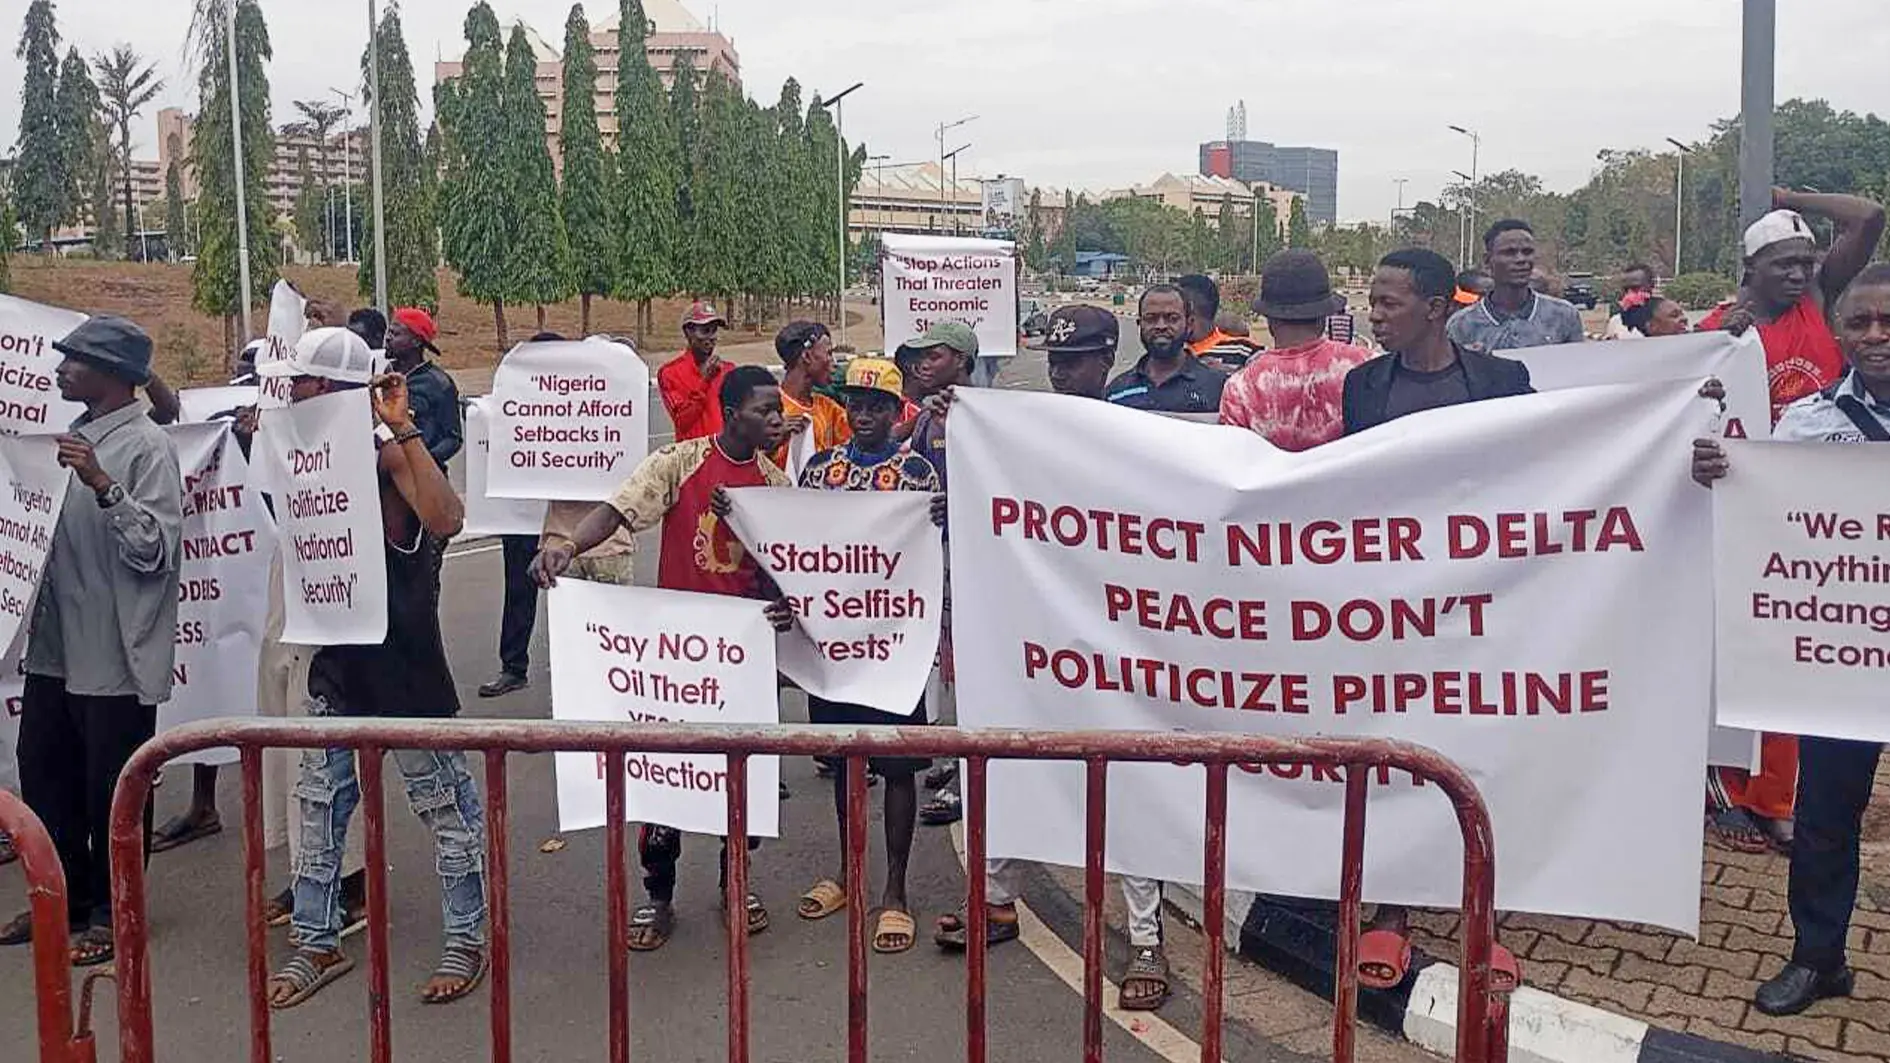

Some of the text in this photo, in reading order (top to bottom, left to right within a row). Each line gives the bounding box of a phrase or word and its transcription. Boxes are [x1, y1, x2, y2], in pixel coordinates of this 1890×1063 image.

[942, 256, 1001, 270] Actions
[894, 276, 1002, 291] That Threaten
[909, 296, 989, 312] Economic
[530, 375, 606, 396] “Nigeria
[502, 400, 633, 418] Cannot Afford
[514, 425, 621, 443] Setbacks in
[287, 442, 331, 475] “Don't
[510, 451, 624, 472] Oil Security”
[991, 496, 1646, 567] PROTECT NIGER DELTA
[1786, 512, 1864, 540] “We
[294, 528, 354, 563] National
[757, 543, 902, 580] “Stability
[824, 589, 925, 619] Selfish
[1104, 583, 1494, 642] PEACE DON’T
[586, 622, 746, 665] “Say NO to
[608, 666, 726, 711] Oil Theft,
[1023, 641, 1610, 716] POLITICIZE PIPELINE
